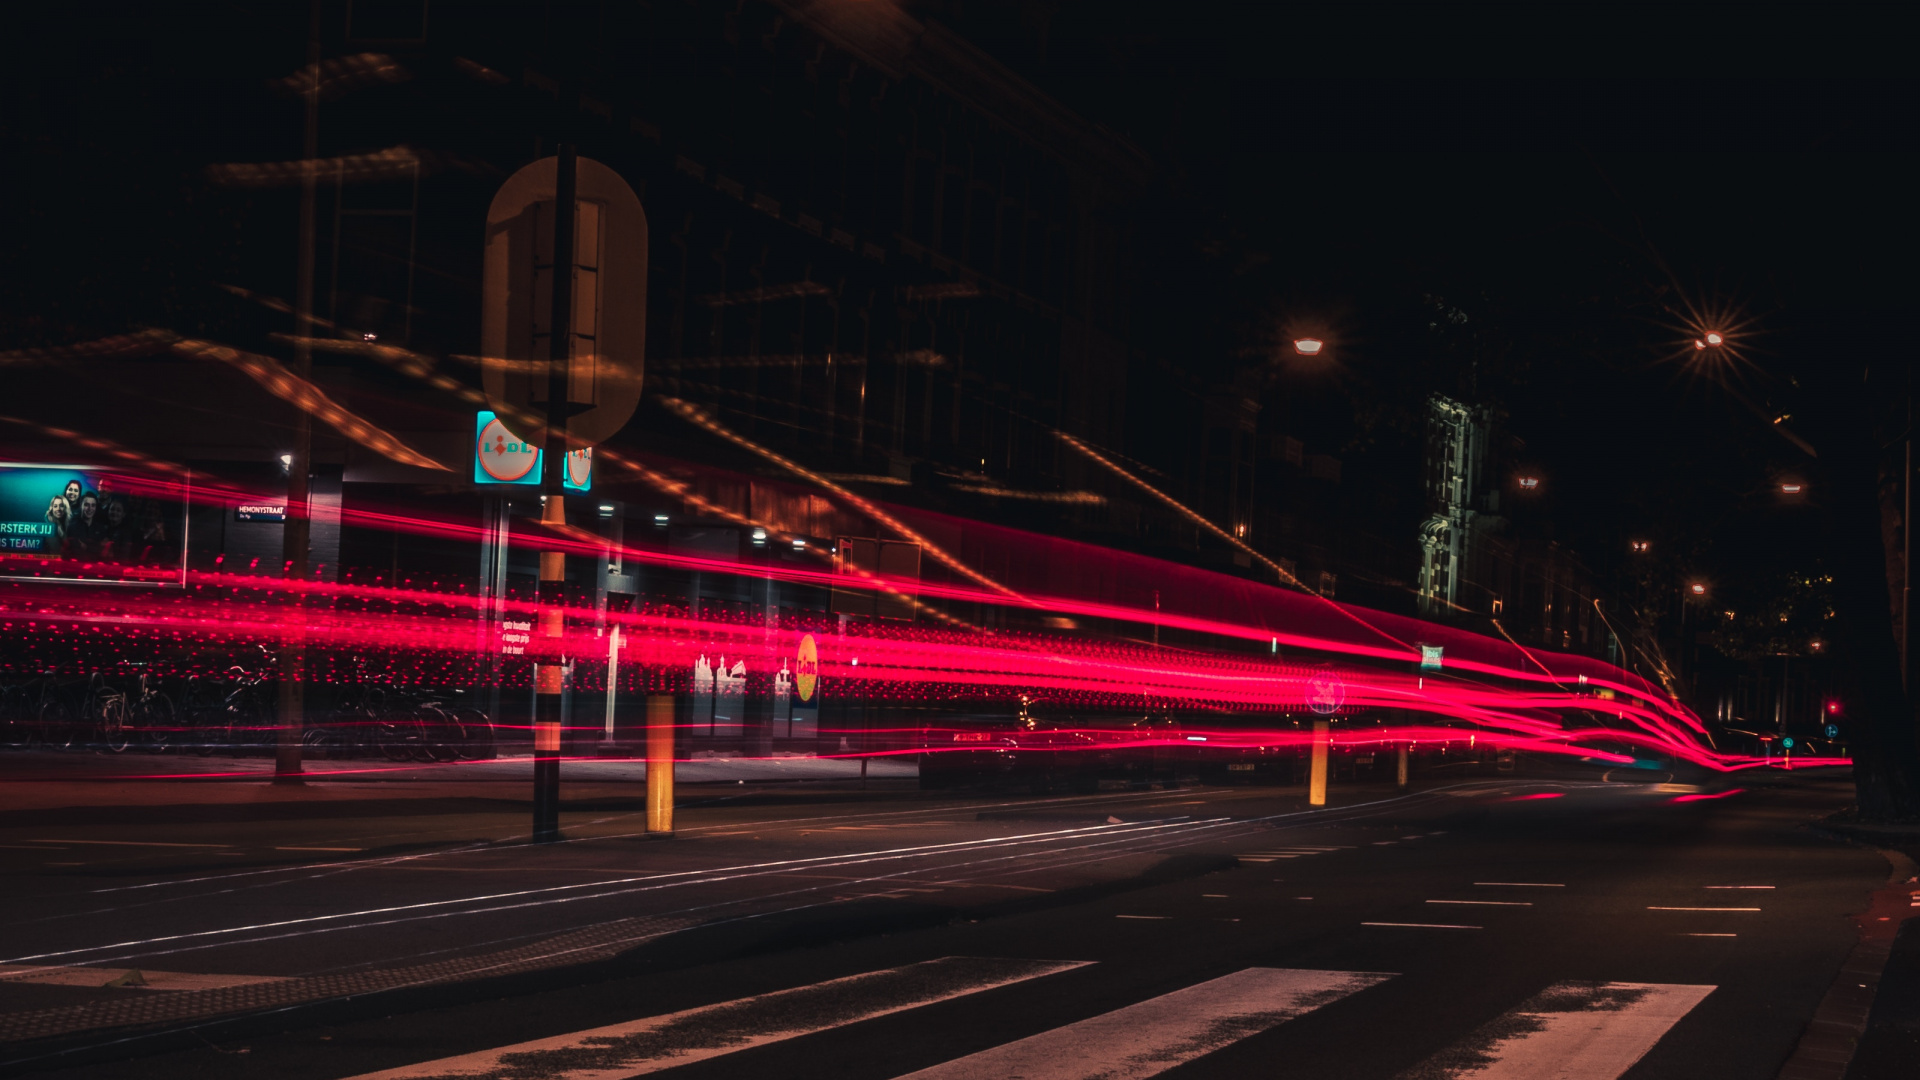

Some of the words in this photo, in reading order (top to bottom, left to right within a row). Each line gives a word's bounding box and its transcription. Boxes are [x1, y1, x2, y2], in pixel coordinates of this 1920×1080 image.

[239, 506, 284, 514] HEMONYSTRAAT
[39, 524, 52, 535] JIJ
[10, 538, 40, 549] TEAM?
